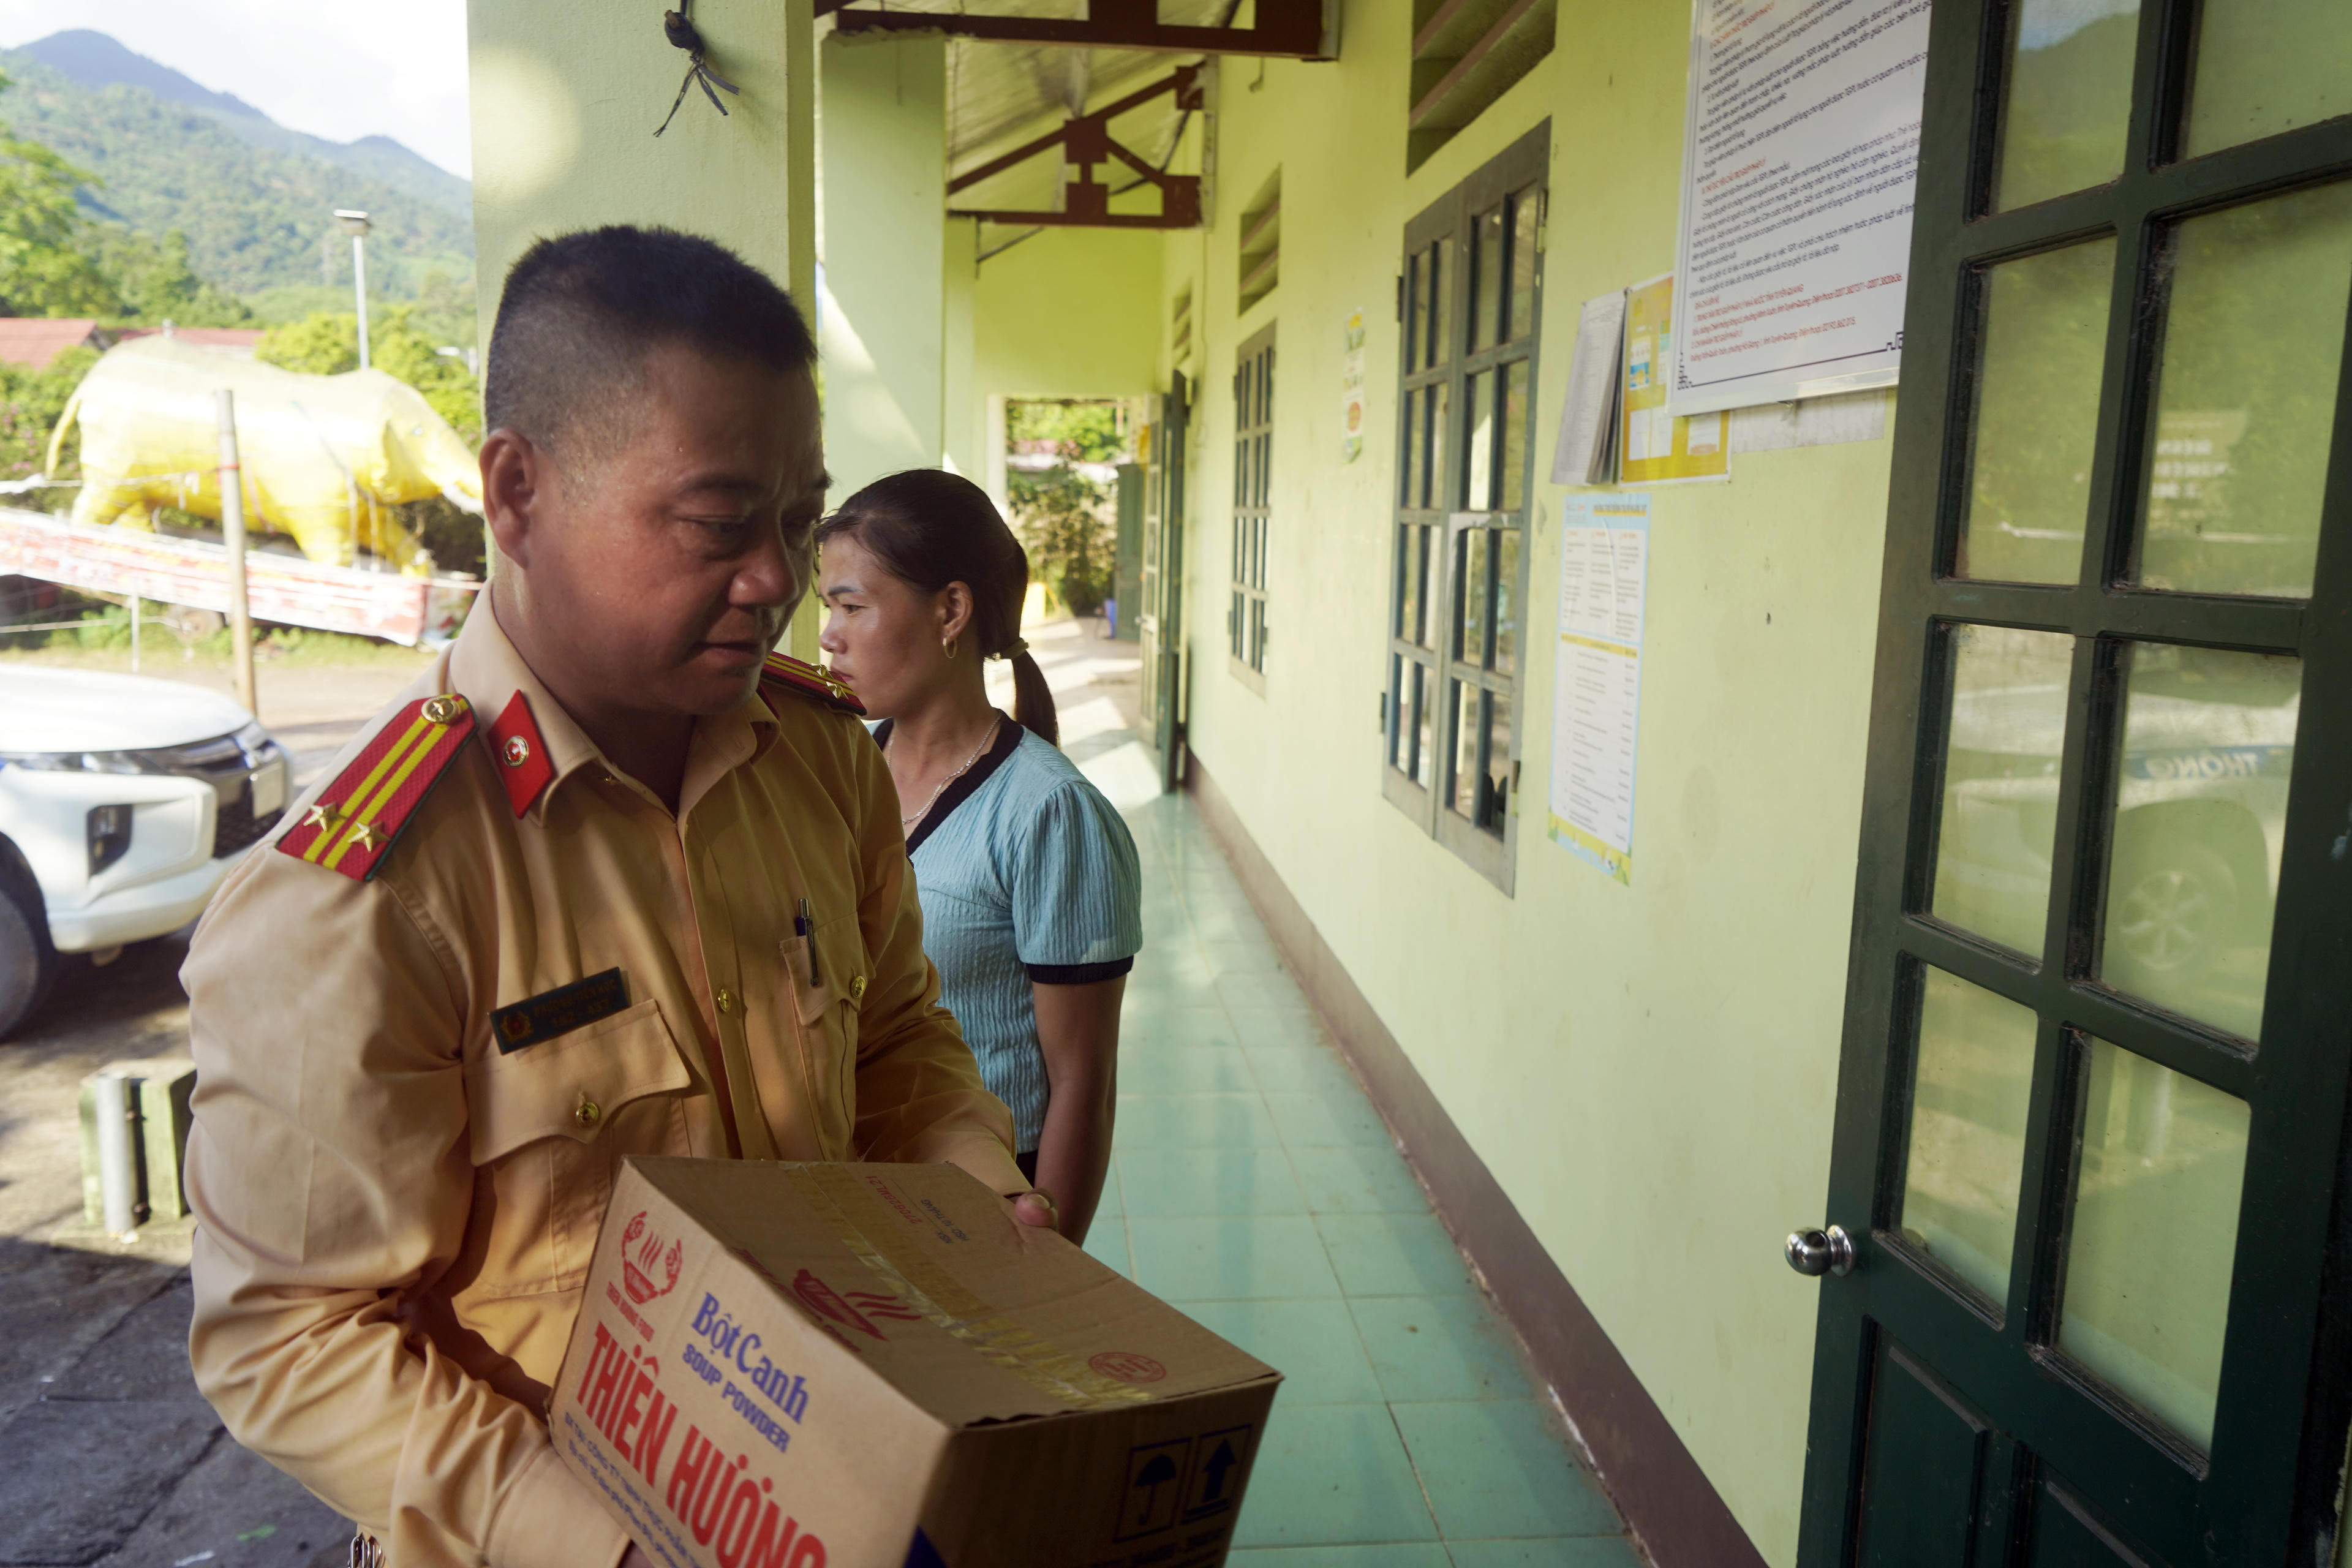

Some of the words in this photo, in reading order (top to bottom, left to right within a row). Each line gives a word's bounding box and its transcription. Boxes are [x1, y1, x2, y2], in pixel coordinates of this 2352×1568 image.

[576, 1319, 679, 1489] THIÊN
[682, 1343, 723, 1387] SOUP
[721, 1381, 791, 1454] POWDER
